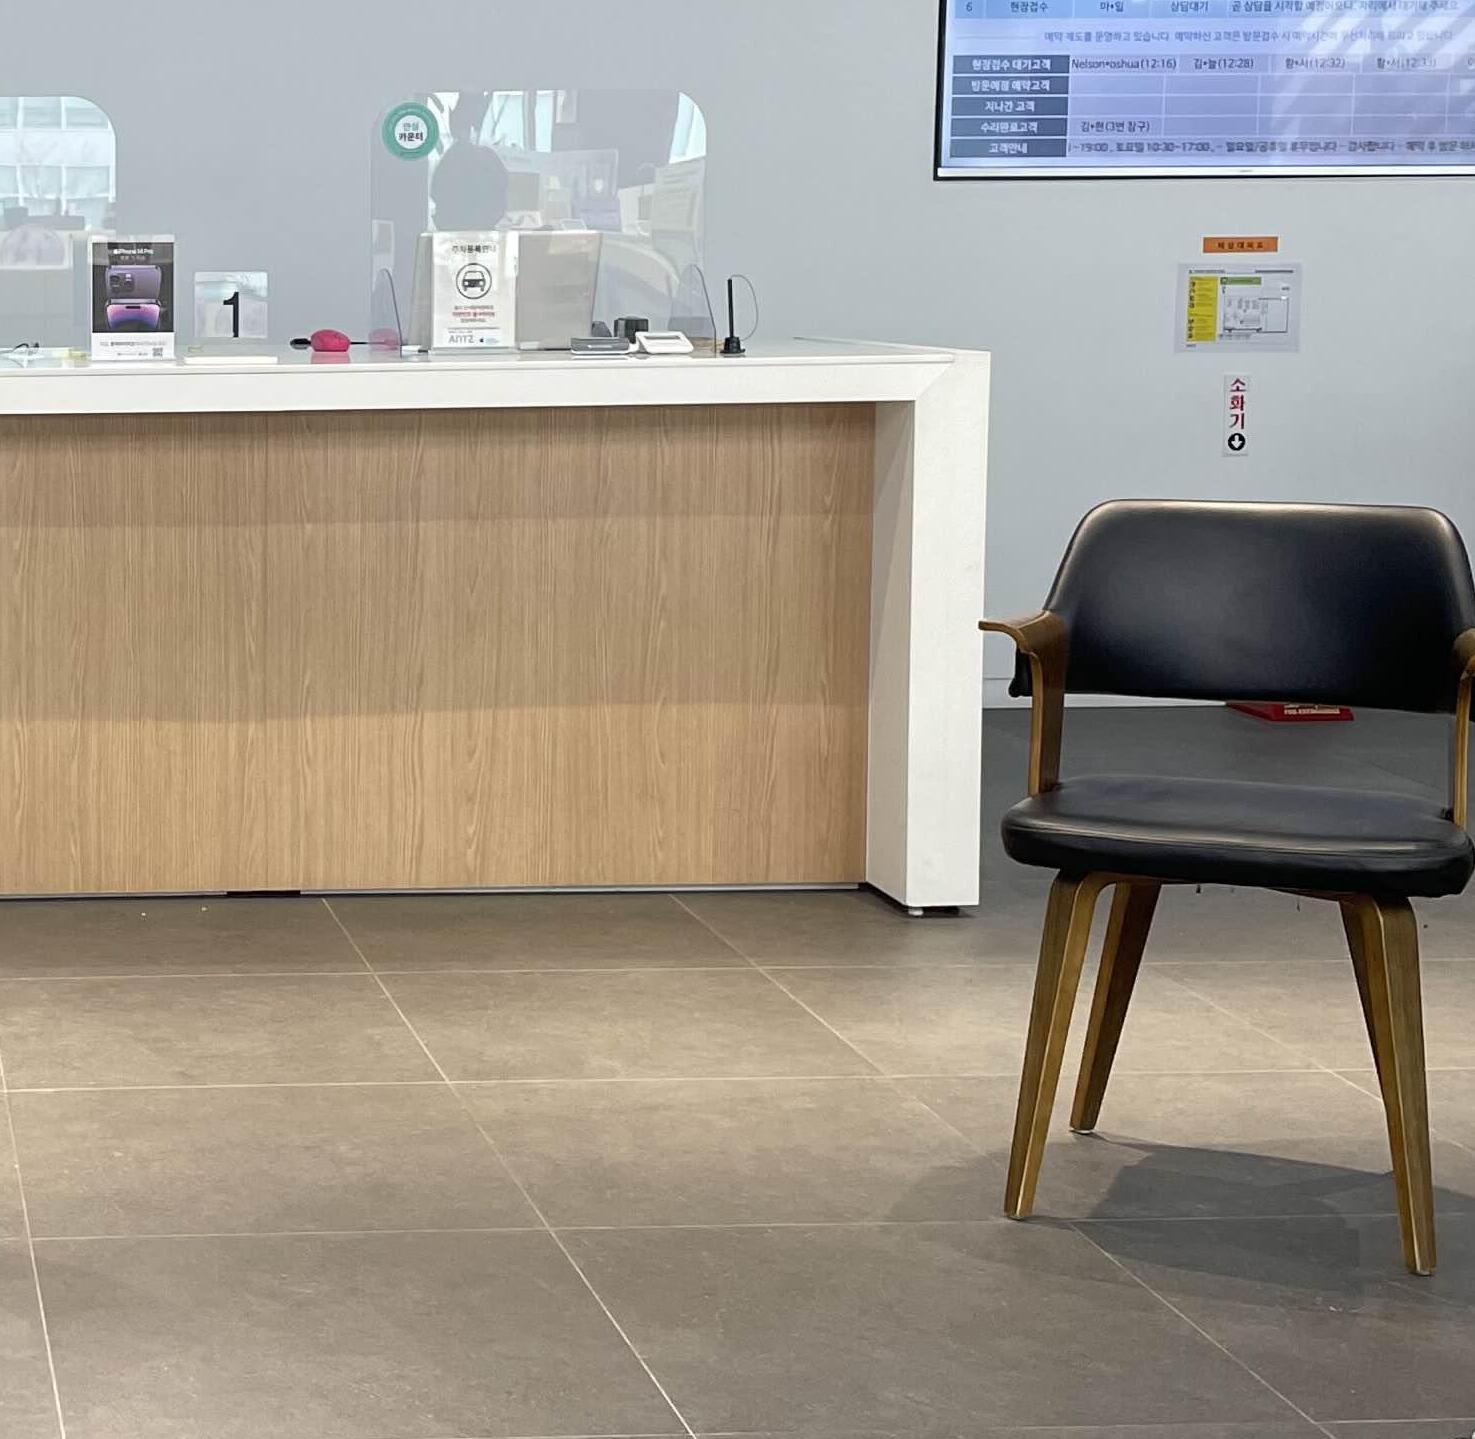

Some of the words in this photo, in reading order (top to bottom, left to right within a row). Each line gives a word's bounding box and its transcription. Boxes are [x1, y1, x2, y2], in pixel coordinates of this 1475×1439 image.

[966, 2, 972, 12] 6
[1010, 1, 1048, 13] 현장접수
[1170, 1, 1208, 12] 상담대기
[1244, 0, 1271, 12] 상담을
[972, 59, 1009, 71] 현장접수
[1013, 59, 1051, 70] 대기고객
[971, 80, 1009, 92] 방문예정
[1012, 80, 1050, 91] 예약고객
[985, 101, 1013, 112] 지나간
[1016, 101, 1035, 112] 고객
[981, 122, 1037, 133] 수리완료고객
[399, 132, 424, 141] 카운터
[989, 143, 1028, 154] 고객안내
[223, 292, 239, 338] 1
[1230, 378, 1246, 430] 소화기
